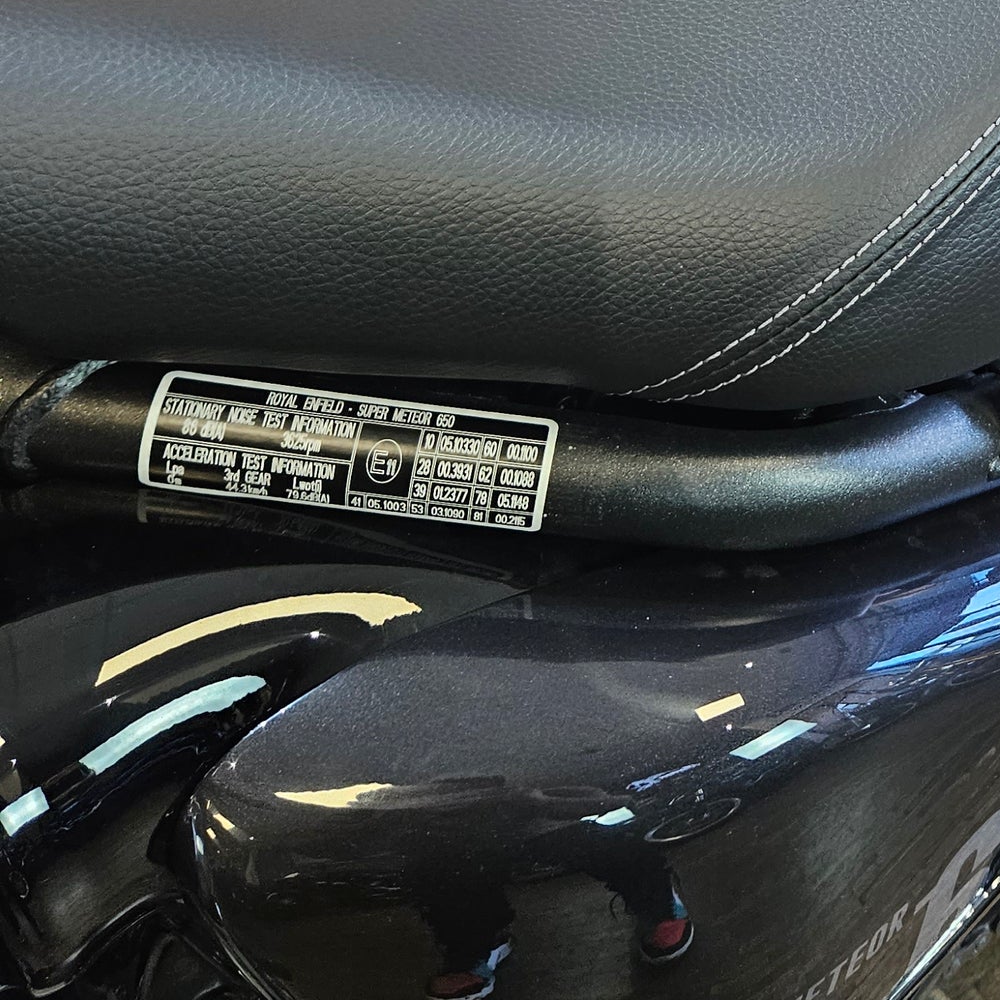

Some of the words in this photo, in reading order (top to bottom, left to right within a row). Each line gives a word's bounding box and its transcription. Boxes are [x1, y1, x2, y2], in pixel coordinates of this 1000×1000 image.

[163, 396, 225, 421] STATIONARY
[227, 406, 259, 427] NOISE
[262, 411, 287, 431] TEST
[291, 415, 357, 439] INFORMATION
[266, 391, 298, 409] ROYAL
[303, 396, 344, 415] ENFIELD
[357, 403, 389, 421] SUPER
[392, 408, 432, 426] METEOR
[436, 413, 455, 428] 650
[424, 432, 436, 450] 10
[484, 441, 498, 458] 60
[162, 443, 237, 468] ACCELERATION
[241, 453, 266, 473] TEST
[270, 457, 336, 481] INFORMATION
[416, 458, 432, 476] 28
[478, 467, 492, 484] 62
[223, 468, 240, 482] 3rd
[244, 471, 271, 486] GEAR
[413, 483, 427, 499] 39
[474, 490, 488, 506] 78
[350, 496, 363, 508] 41
[367, 499, 407, 513] 05.1003
[411, 503, 424, 515] 53
[430, 506, 465, 520] 03.1090
[473, 511, 484, 522] 81
[795, 902, 909, 1000] ETEOR
